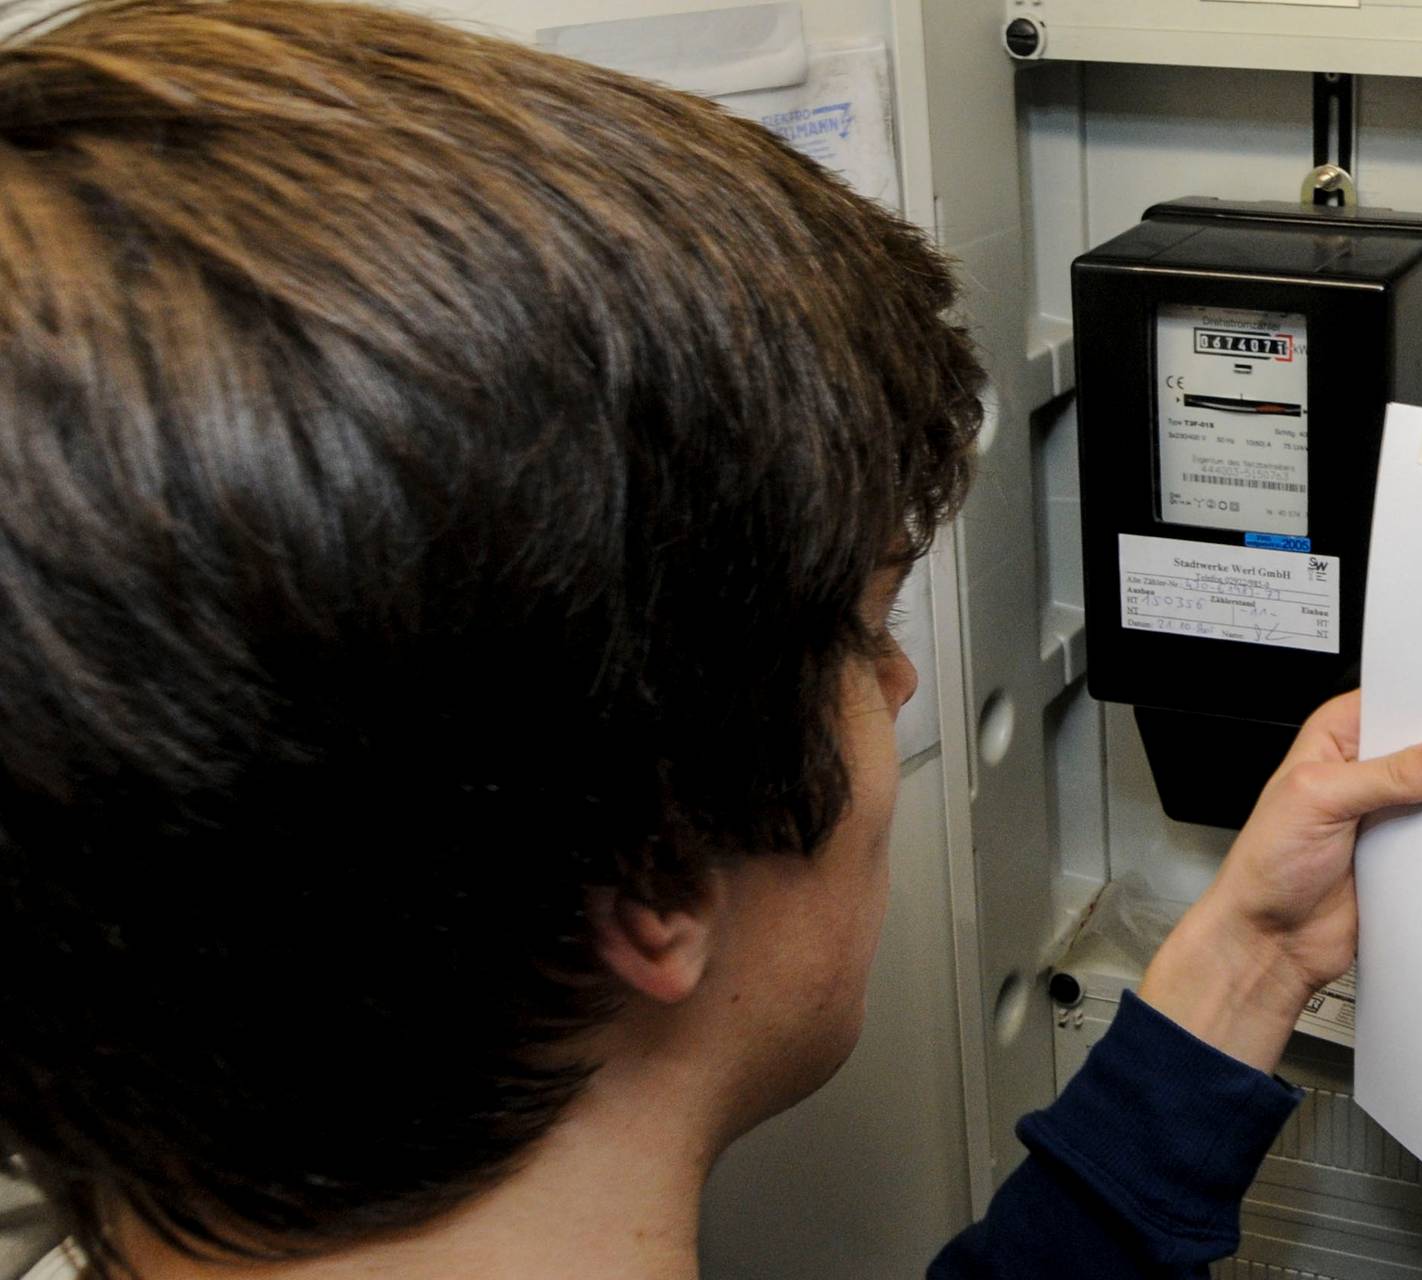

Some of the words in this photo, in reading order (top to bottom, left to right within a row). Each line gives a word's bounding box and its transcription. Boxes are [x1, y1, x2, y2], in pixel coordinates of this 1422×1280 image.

[1173, 557, 1229, 573] Stadtwerke
[1231, 564, 1256, 577] Werl
[1258, 567, 1291, 580] GmbH
